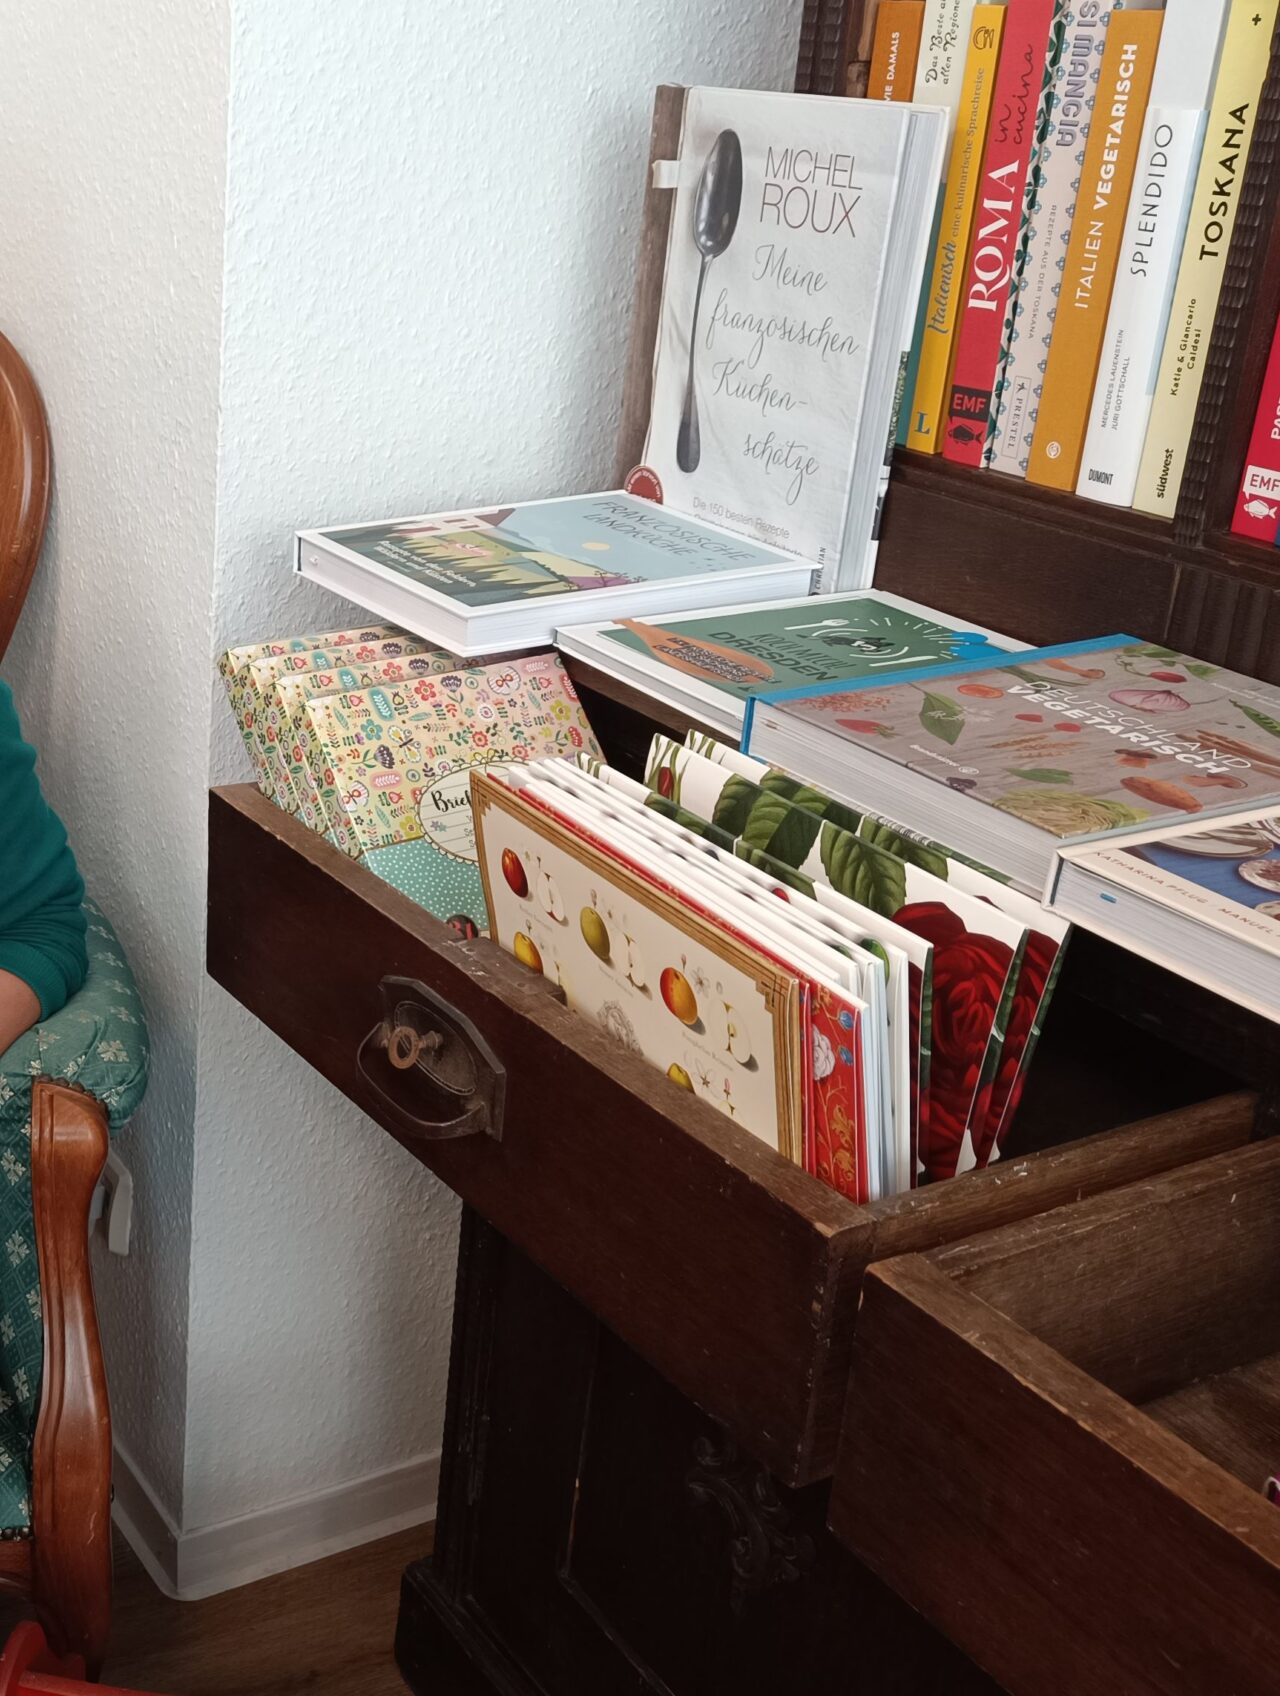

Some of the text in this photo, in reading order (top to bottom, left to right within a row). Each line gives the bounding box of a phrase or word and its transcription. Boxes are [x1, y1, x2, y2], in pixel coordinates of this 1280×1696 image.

[887, 32, 900, 80] DAMALS
[930, 14, 944, 51] Beste
[925, 56, 938, 83] Das
[941, 56, 952, 84] allen
[1012, 43, 1034, 145] cucina
[994, 103, 1012, 143] in
[765, 146, 863, 191] MICHEL
[1074, 44, 1138, 309] ITALIEN VEGETARISCH
[1199, 103, 1249, 261] TOSKANA
[760, 183, 861, 238] ROUX
[927, 68, 985, 335] Italienisch eine kulinarische Sprachreise
[1131, 125, 1173, 277] SPLENDIDO
[968, 159, 1019, 312] ROMA
[752, 244, 828, 296] Meine
[1028, 204, 1057, 340] REZEPTE AUS DER TOSKANA
[1170, 298, 1196, 396] Katie & Giancarlo
[1187, 328, 1202, 370] Caldesi
[953, 392, 987, 413] EMF
[1101, 328, 1124, 429] MERCEDES LAUENSTEIN
[1111, 357, 1131, 431] JURI GOTTSCHALL
[914, 411, 931, 435] L
[1008, 397, 1023, 449] PRESTEL
[1088, 469, 1114, 485] DUMONT
[1250, 473, 1280, 493] EMF
[709, 502, 724, 517] 150
[725, 507, 753, 528] besten
[754, 517, 791, 540] Rezepte
[709, 631, 840, 682] DRESDEN
[1007, 685, 1230, 774] VEGETARISCH
[1025, 681, 1252, 769] DEUTSCHLAND
[1218, 907, 1274, 934] MANUEL
